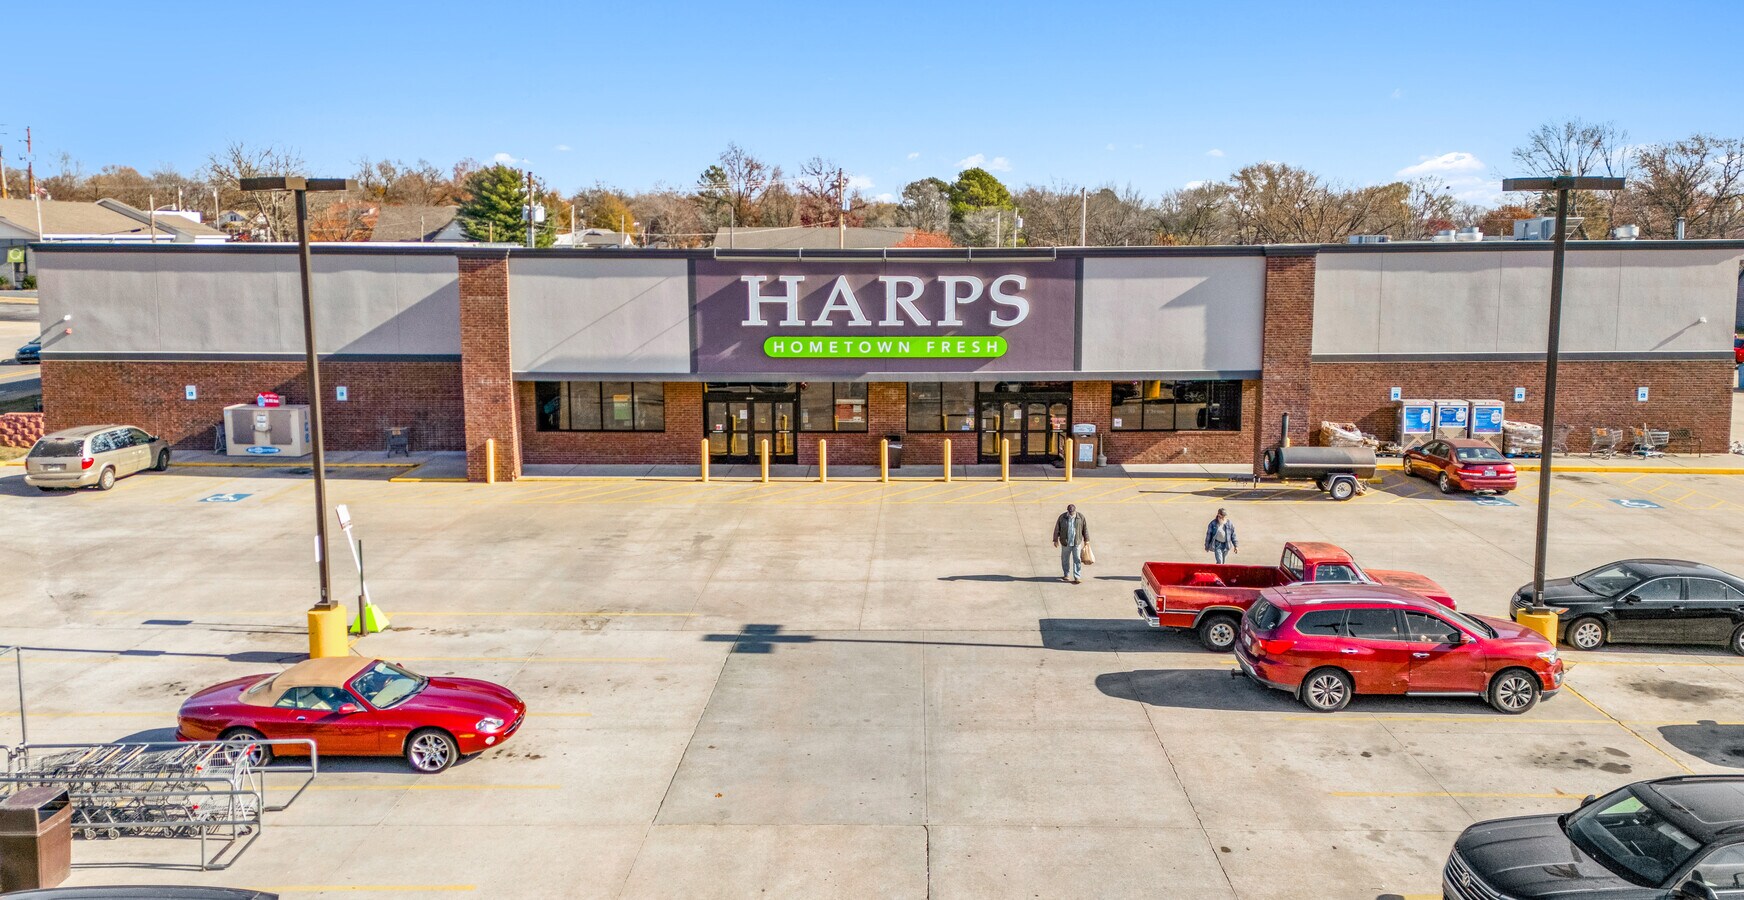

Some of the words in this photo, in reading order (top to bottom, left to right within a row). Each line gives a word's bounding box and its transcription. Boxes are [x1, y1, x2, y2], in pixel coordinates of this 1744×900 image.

[741, 274, 1030, 327] HARPS
[773, 341, 910, 353] HOMETOWN
[927, 341, 998, 353] FRESH
